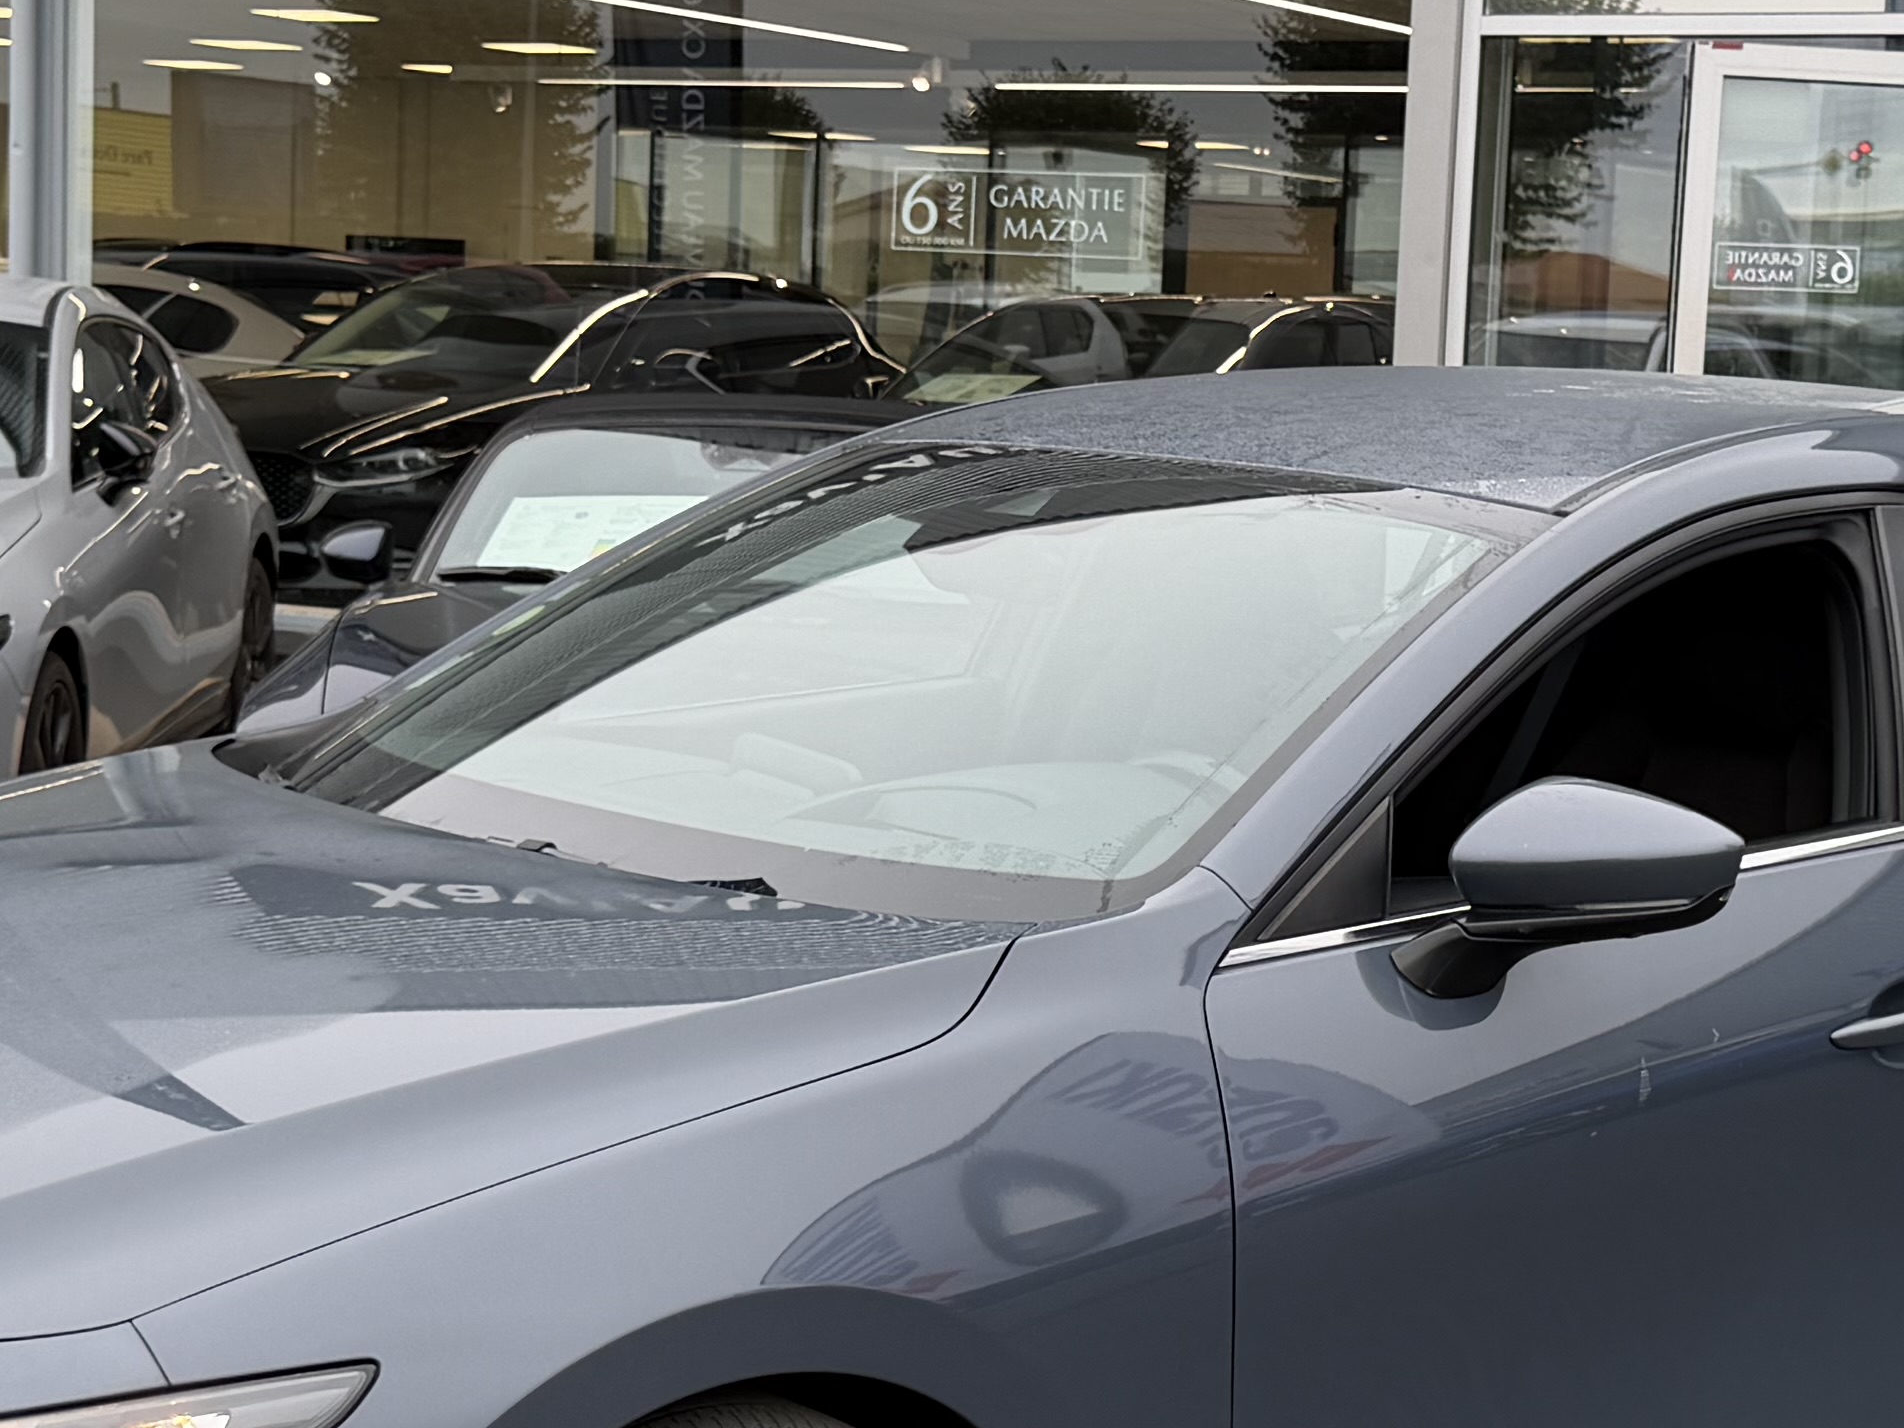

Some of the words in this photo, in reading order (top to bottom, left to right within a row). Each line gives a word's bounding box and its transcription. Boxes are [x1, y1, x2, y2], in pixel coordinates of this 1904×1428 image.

[901, 173, 938, 235] 6
[947, 181, 965, 230] ANS
[989, 185, 1125, 212] GARANTIE
[1003, 217, 1108, 244] MAZDA
